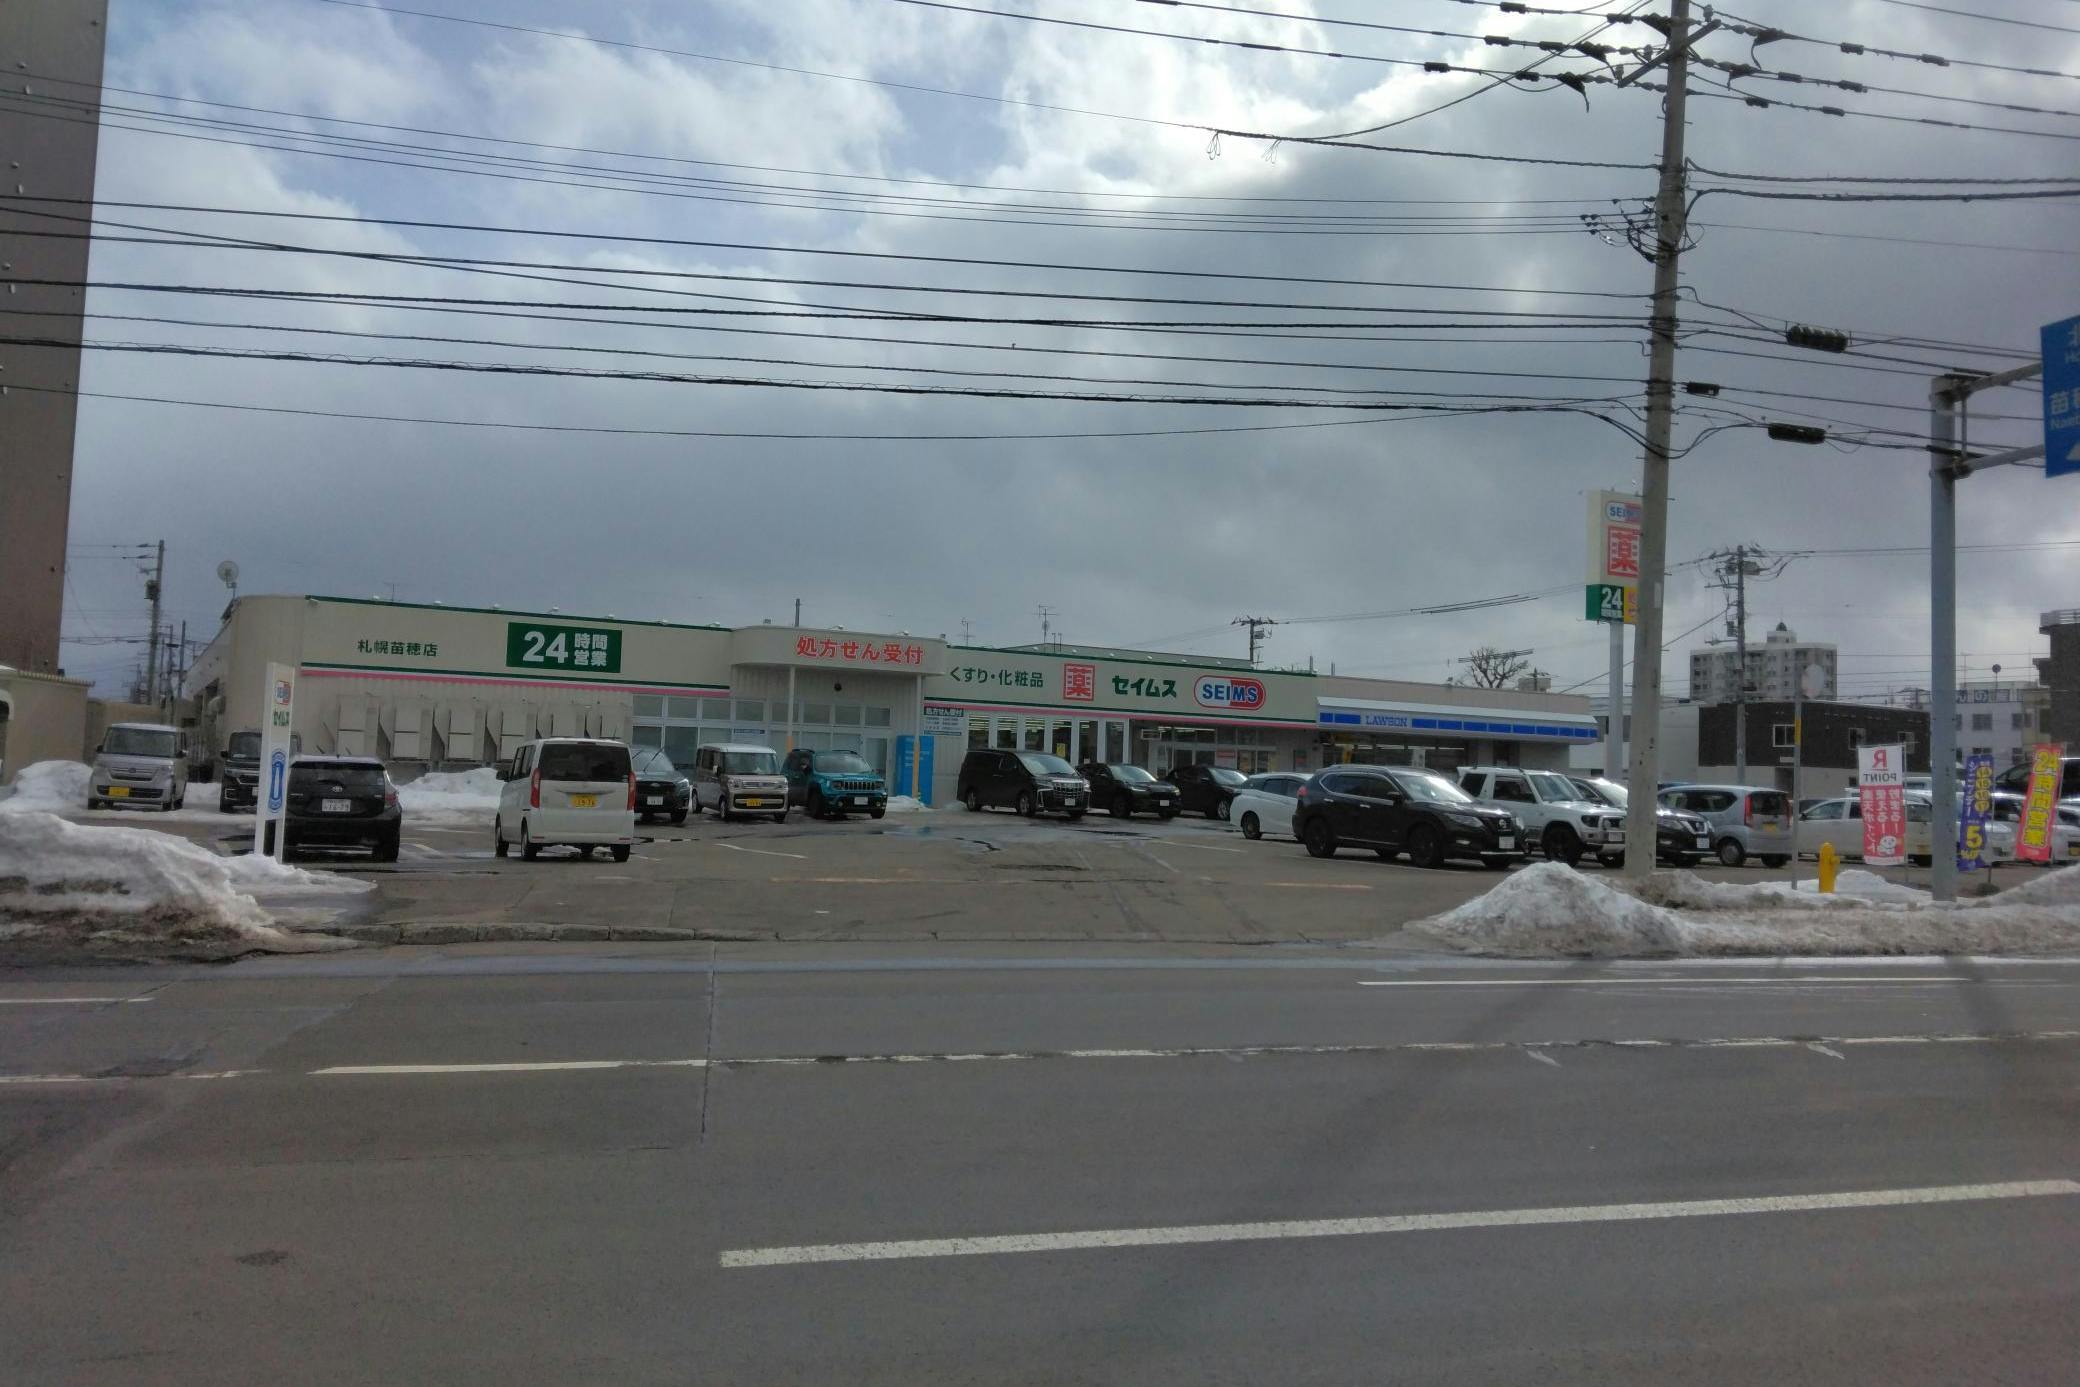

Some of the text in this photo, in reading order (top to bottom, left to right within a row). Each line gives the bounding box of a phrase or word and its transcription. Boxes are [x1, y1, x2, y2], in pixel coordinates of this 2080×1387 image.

[1601, 587, 1623, 610] 24
[357, 639, 438, 657] 札幌苗穂店
[522, 630, 608, 664] 24 時間
[796, 636, 924, 665] 処方せん受付
[573, 650, 608, 667] 営業
[950, 666, 1044, 688] くすり・化粧品
[1065, 665, 1094, 698] 薬
[1111, 675, 1177, 699] セイムス
[1202, 683, 1258, 704] SEIMS
[1365, 714, 1408, 729] LAWSON
[1966, 826, 1983, 848] 5
